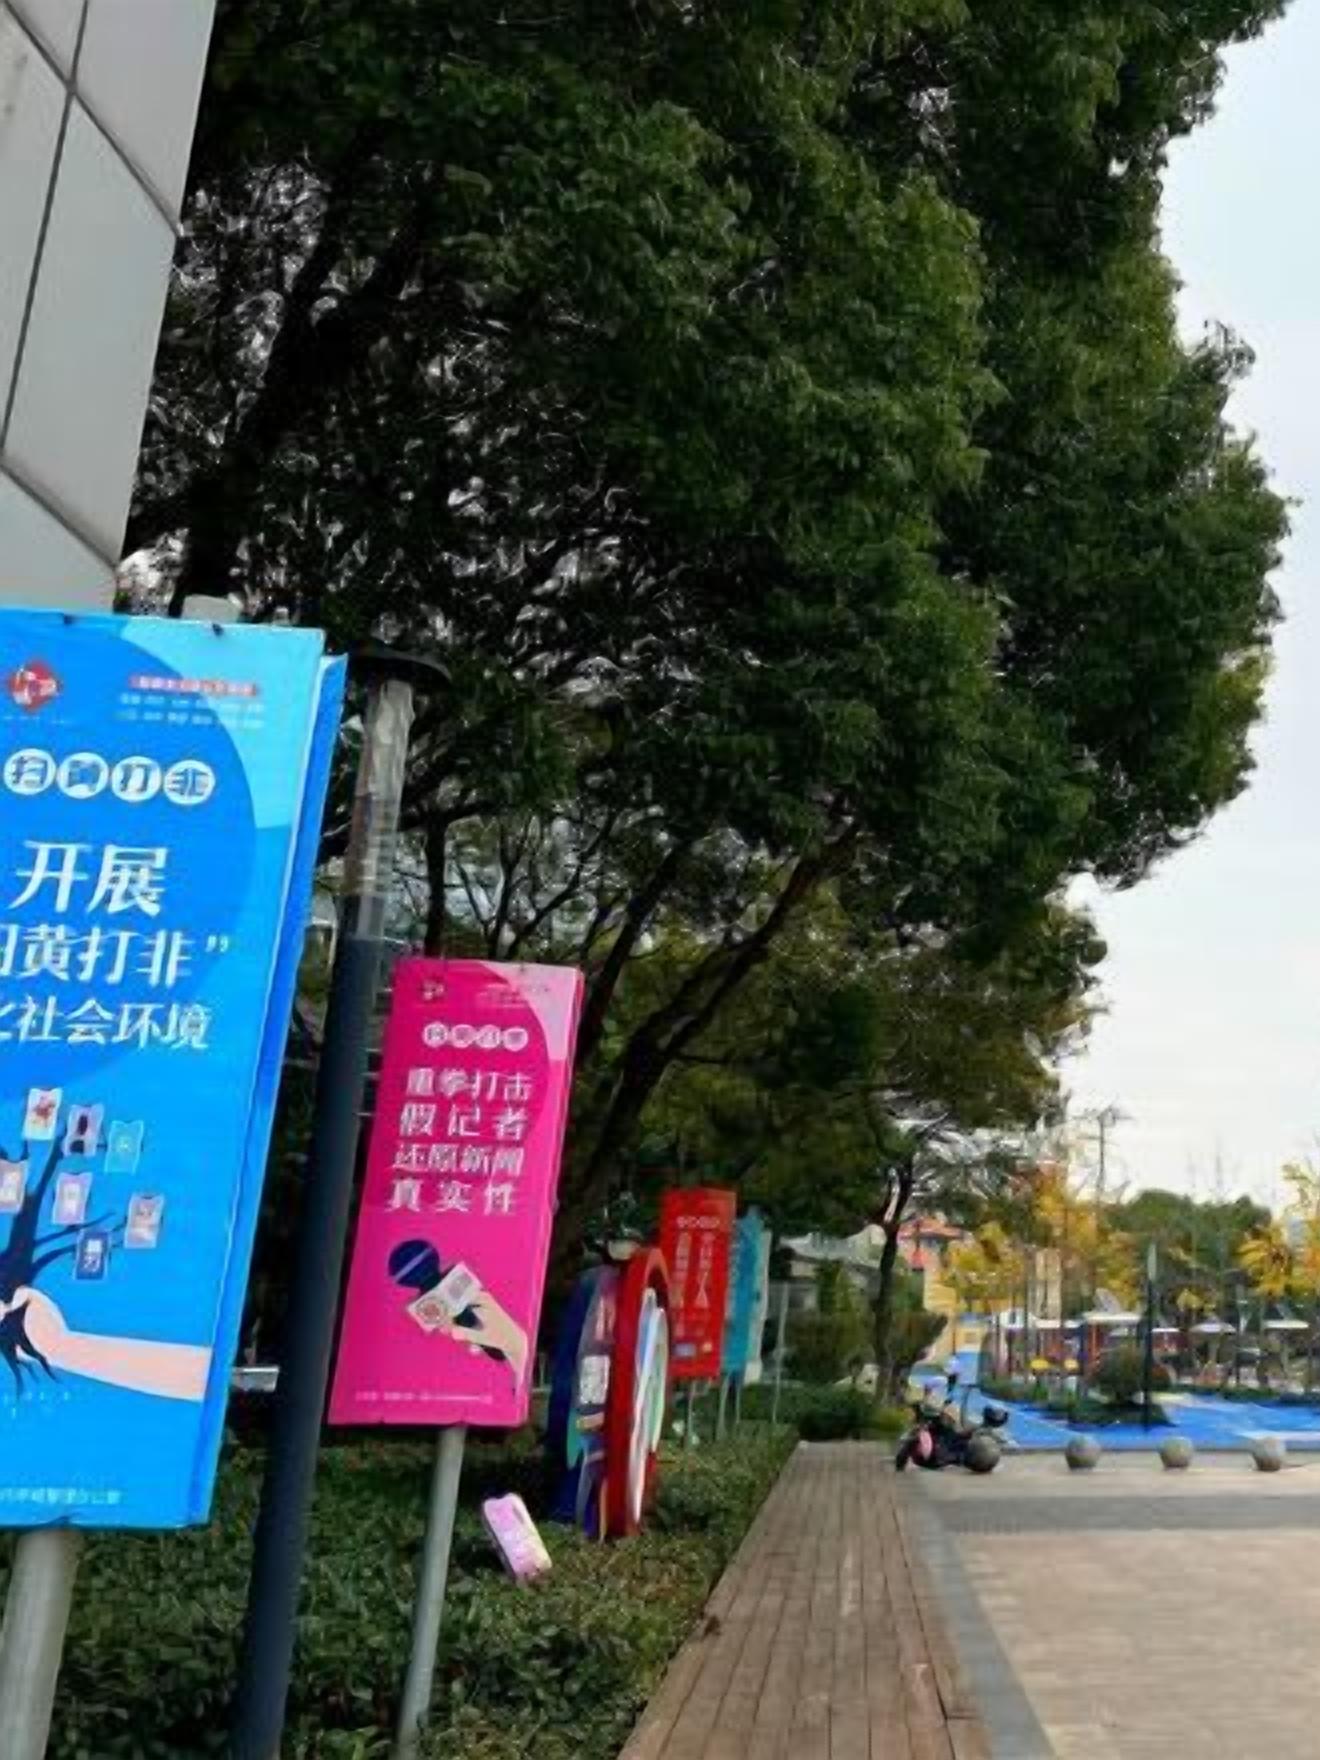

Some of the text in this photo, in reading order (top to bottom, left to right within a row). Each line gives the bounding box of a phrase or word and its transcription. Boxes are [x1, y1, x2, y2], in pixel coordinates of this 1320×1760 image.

[4, 749, 216, 804] 扫打非
[7, 839, 168, 917] 开展
[399, 1103, 528, 1141] 假记者
